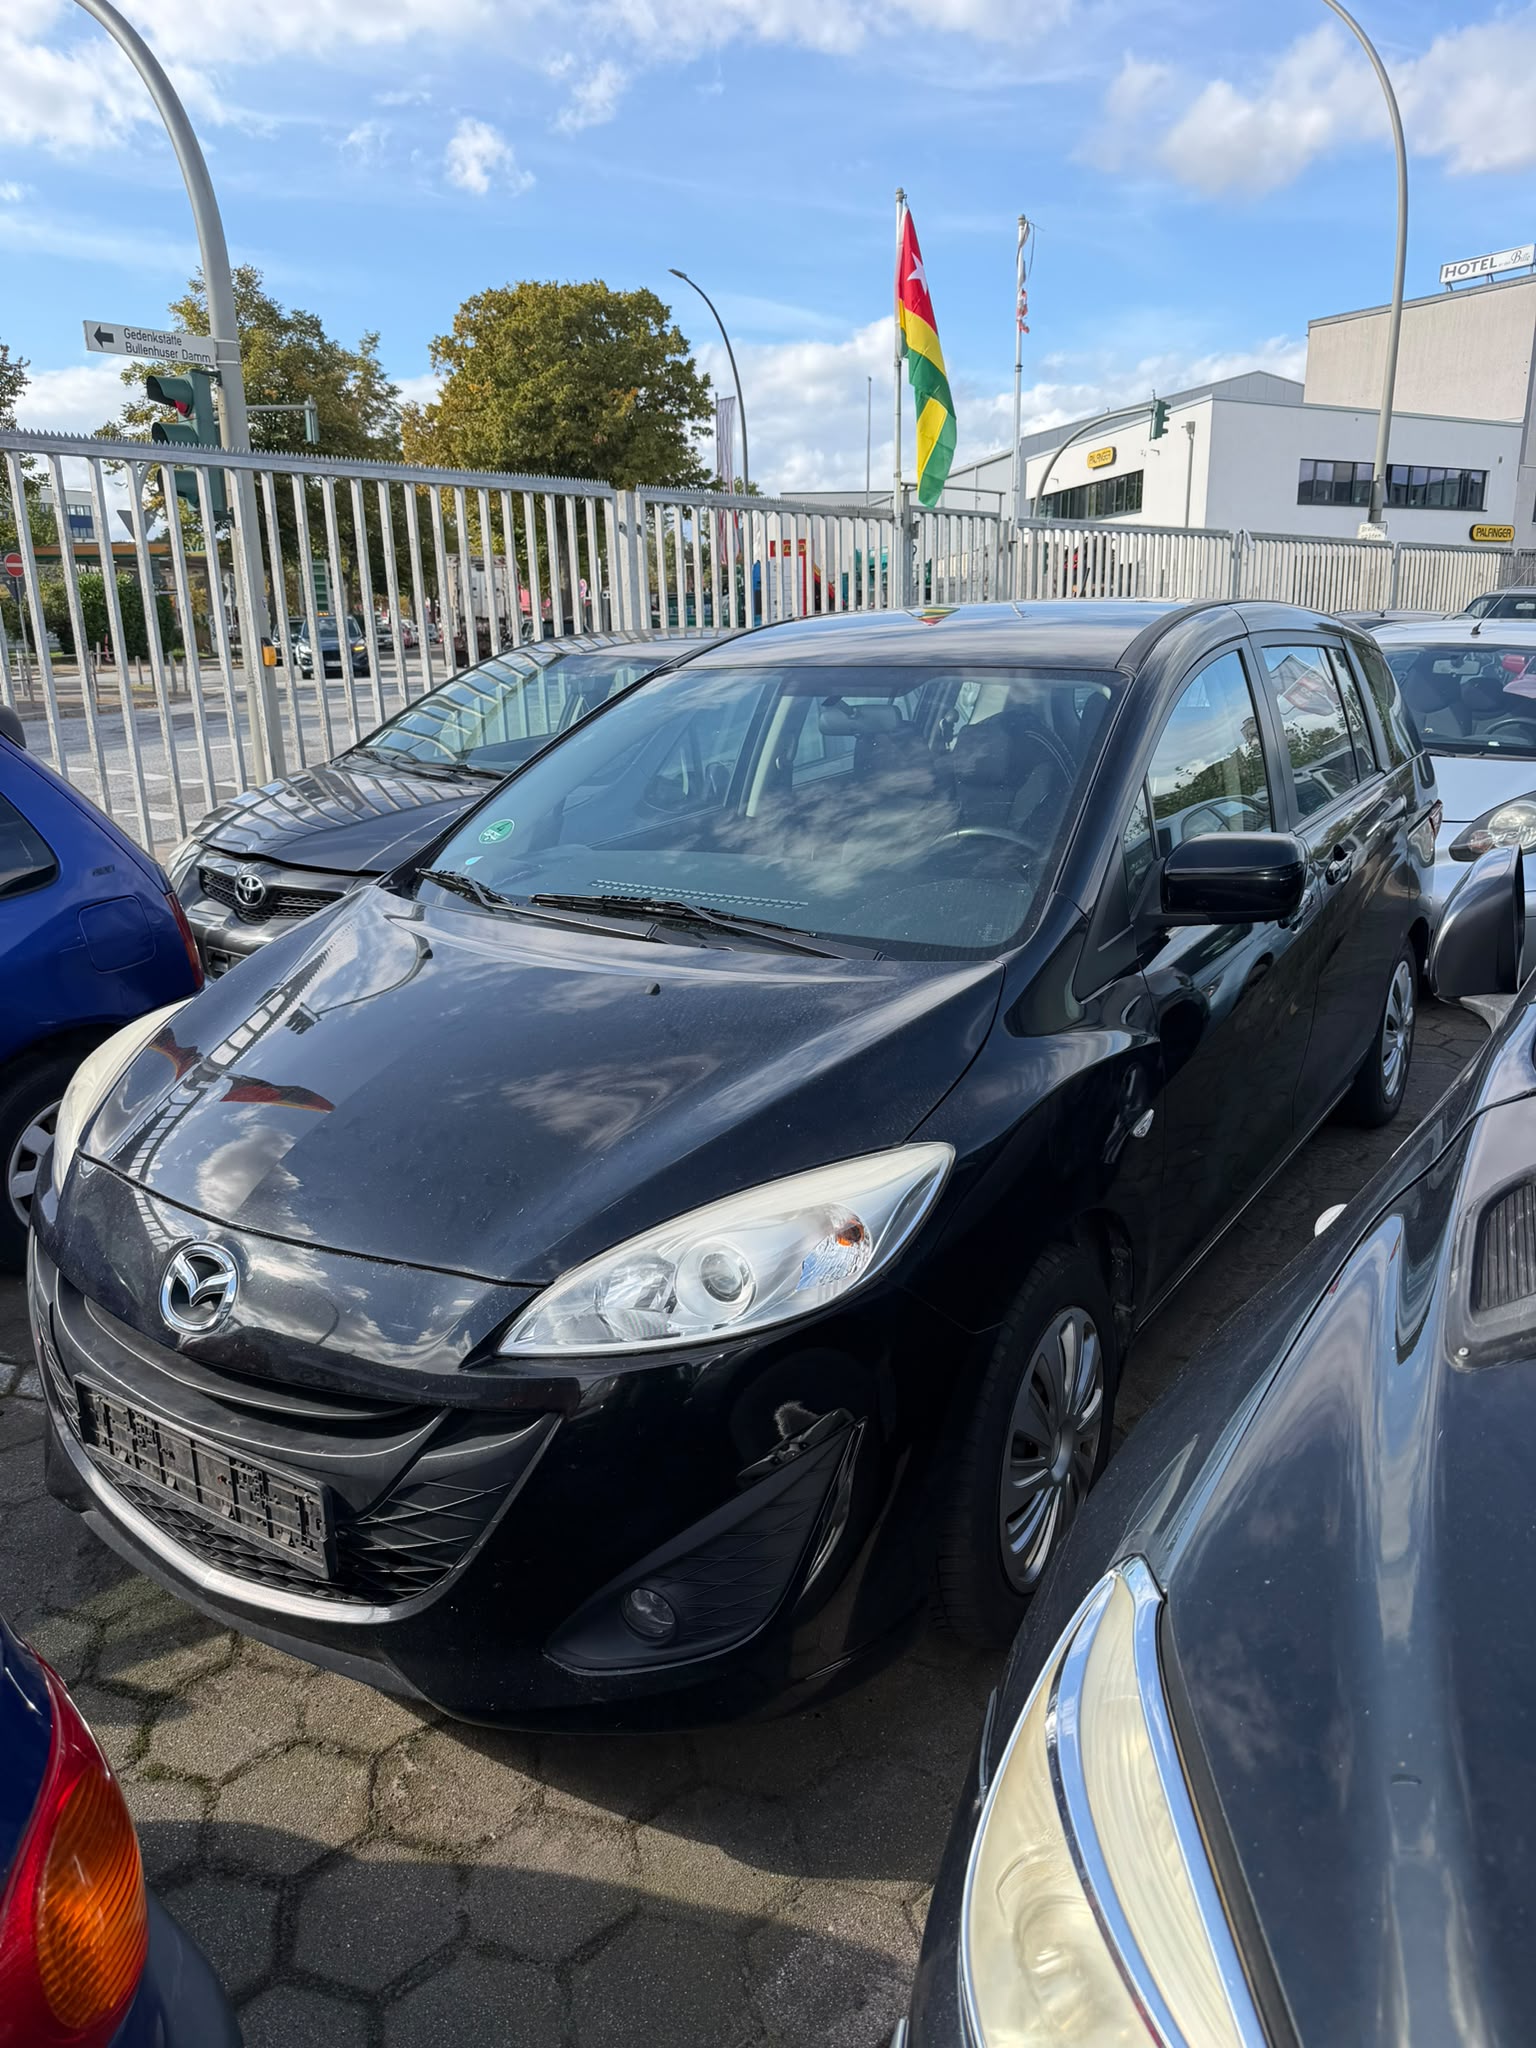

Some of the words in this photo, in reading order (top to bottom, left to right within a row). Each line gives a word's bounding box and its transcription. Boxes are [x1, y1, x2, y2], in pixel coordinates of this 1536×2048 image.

[1444, 257, 1497, 278] HOTEL
[123, 327, 182, 346] Gedenkstätte
[125, 342, 178, 359] Bullenhuser
[182, 349, 211, 363] Damm
[1476, 527, 1512, 538] PALFINGER
